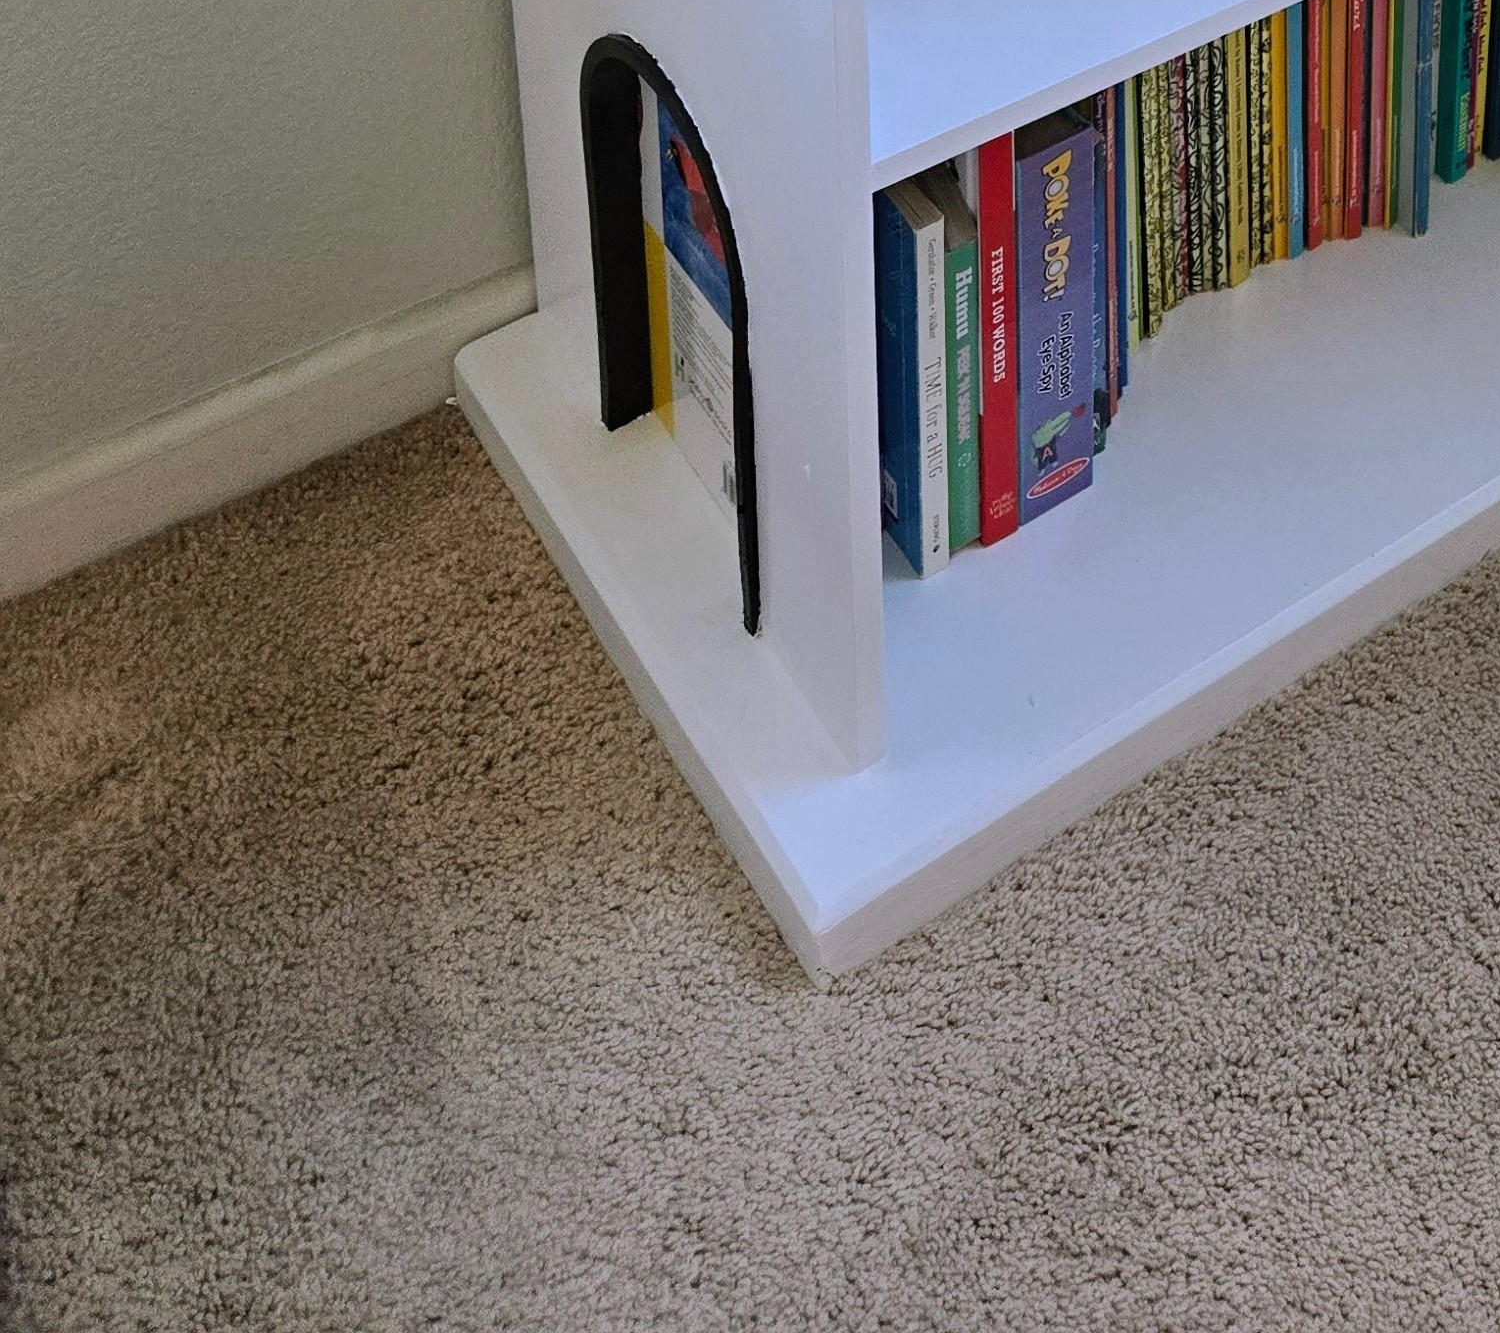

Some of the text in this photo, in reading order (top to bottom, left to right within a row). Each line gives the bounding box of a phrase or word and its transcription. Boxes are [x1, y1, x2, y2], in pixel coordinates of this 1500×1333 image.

[1458, 92, 1471, 153] Eastman
[954, 266, 973, 341] Humu
[990, 247, 1006, 384] FIRST 100 WORDS
[1037, 335, 1056, 395] Eye Spy
[1057, 312, 1074, 401] An Alphabet
[924, 356, 943, 479] TIME for a HUG
